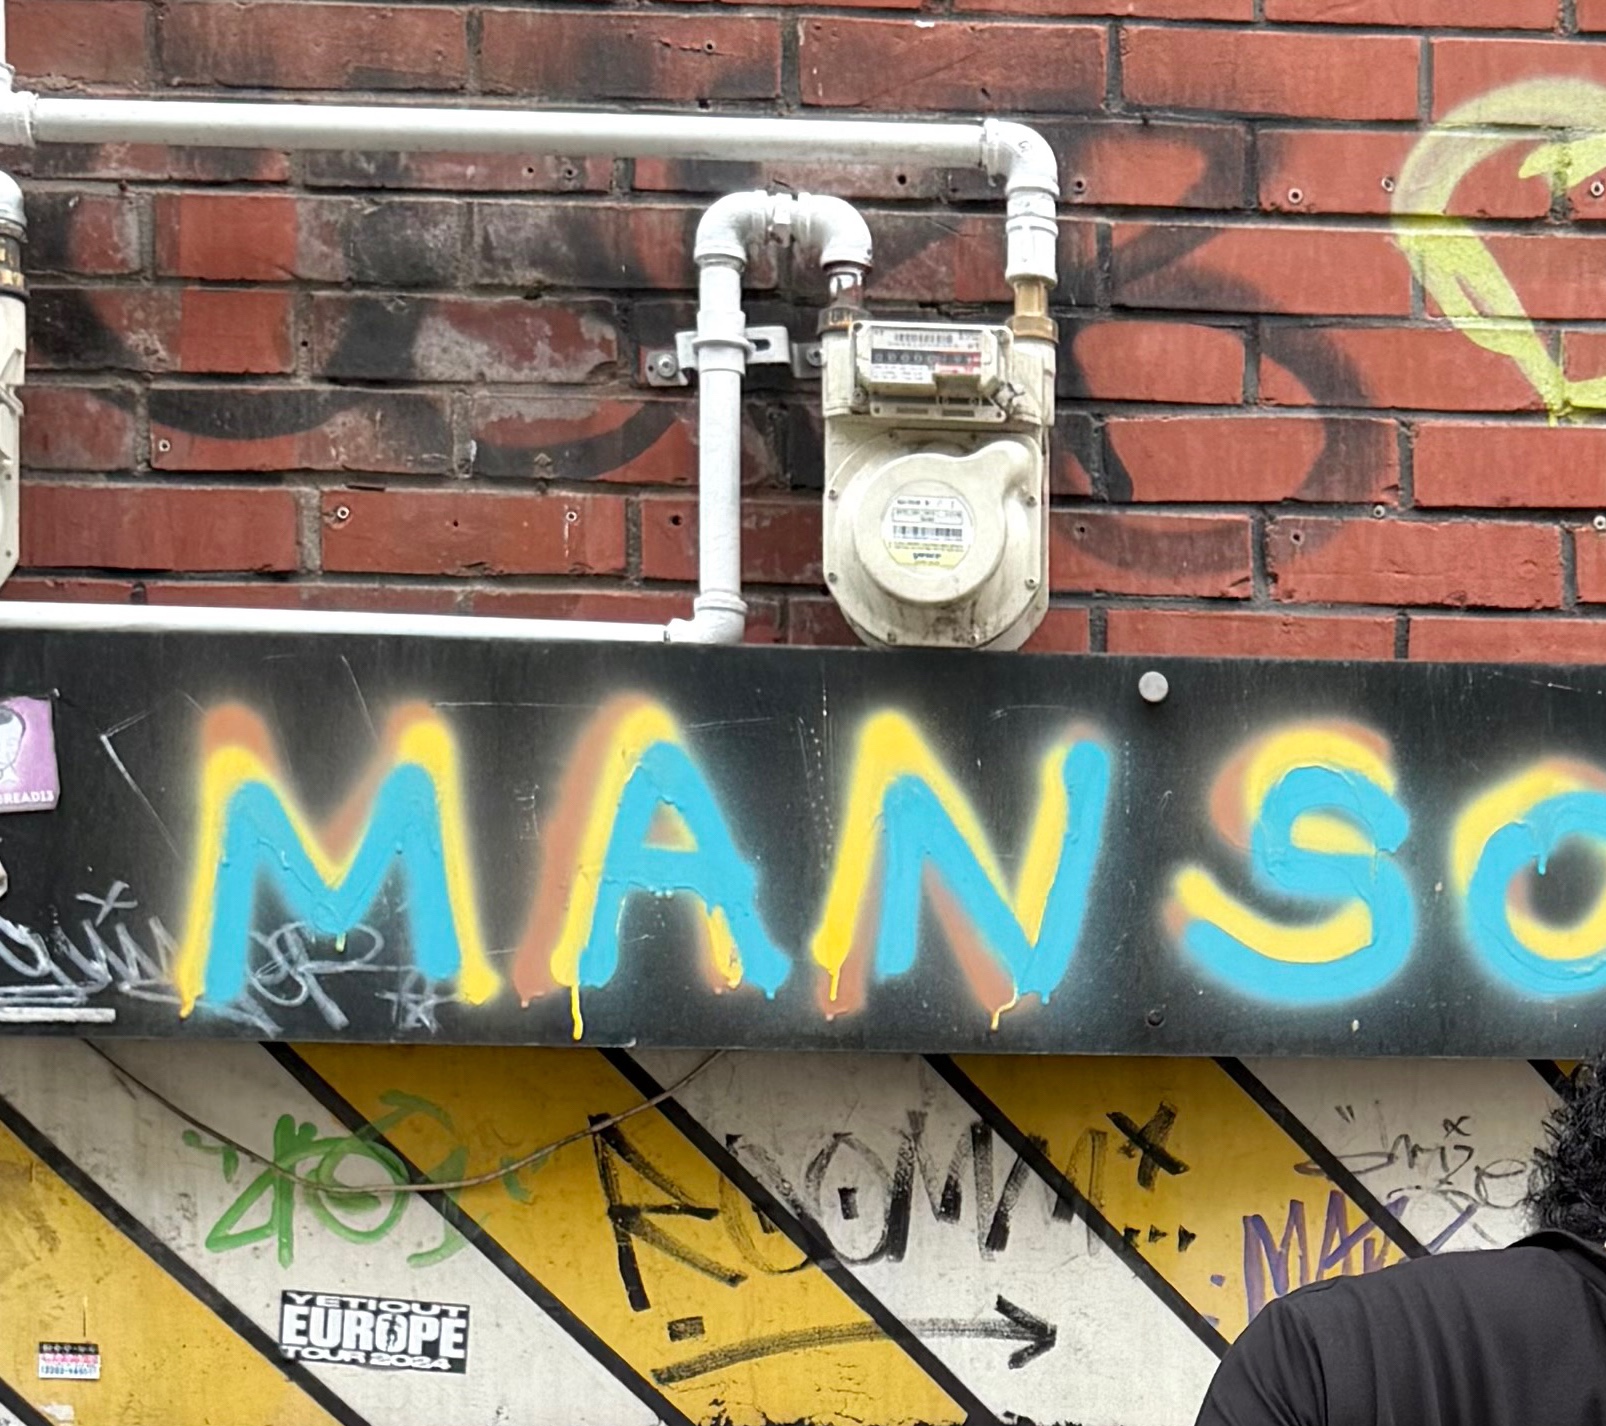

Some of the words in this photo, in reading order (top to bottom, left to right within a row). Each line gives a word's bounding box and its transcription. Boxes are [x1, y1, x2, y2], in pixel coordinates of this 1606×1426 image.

[287, 1292, 468, 1317] YETIOUT
[281, 1303, 467, 1358] EUROPE
[281, 1345, 366, 1363] TOUR
[369, 1352, 452, 1370] 2024
